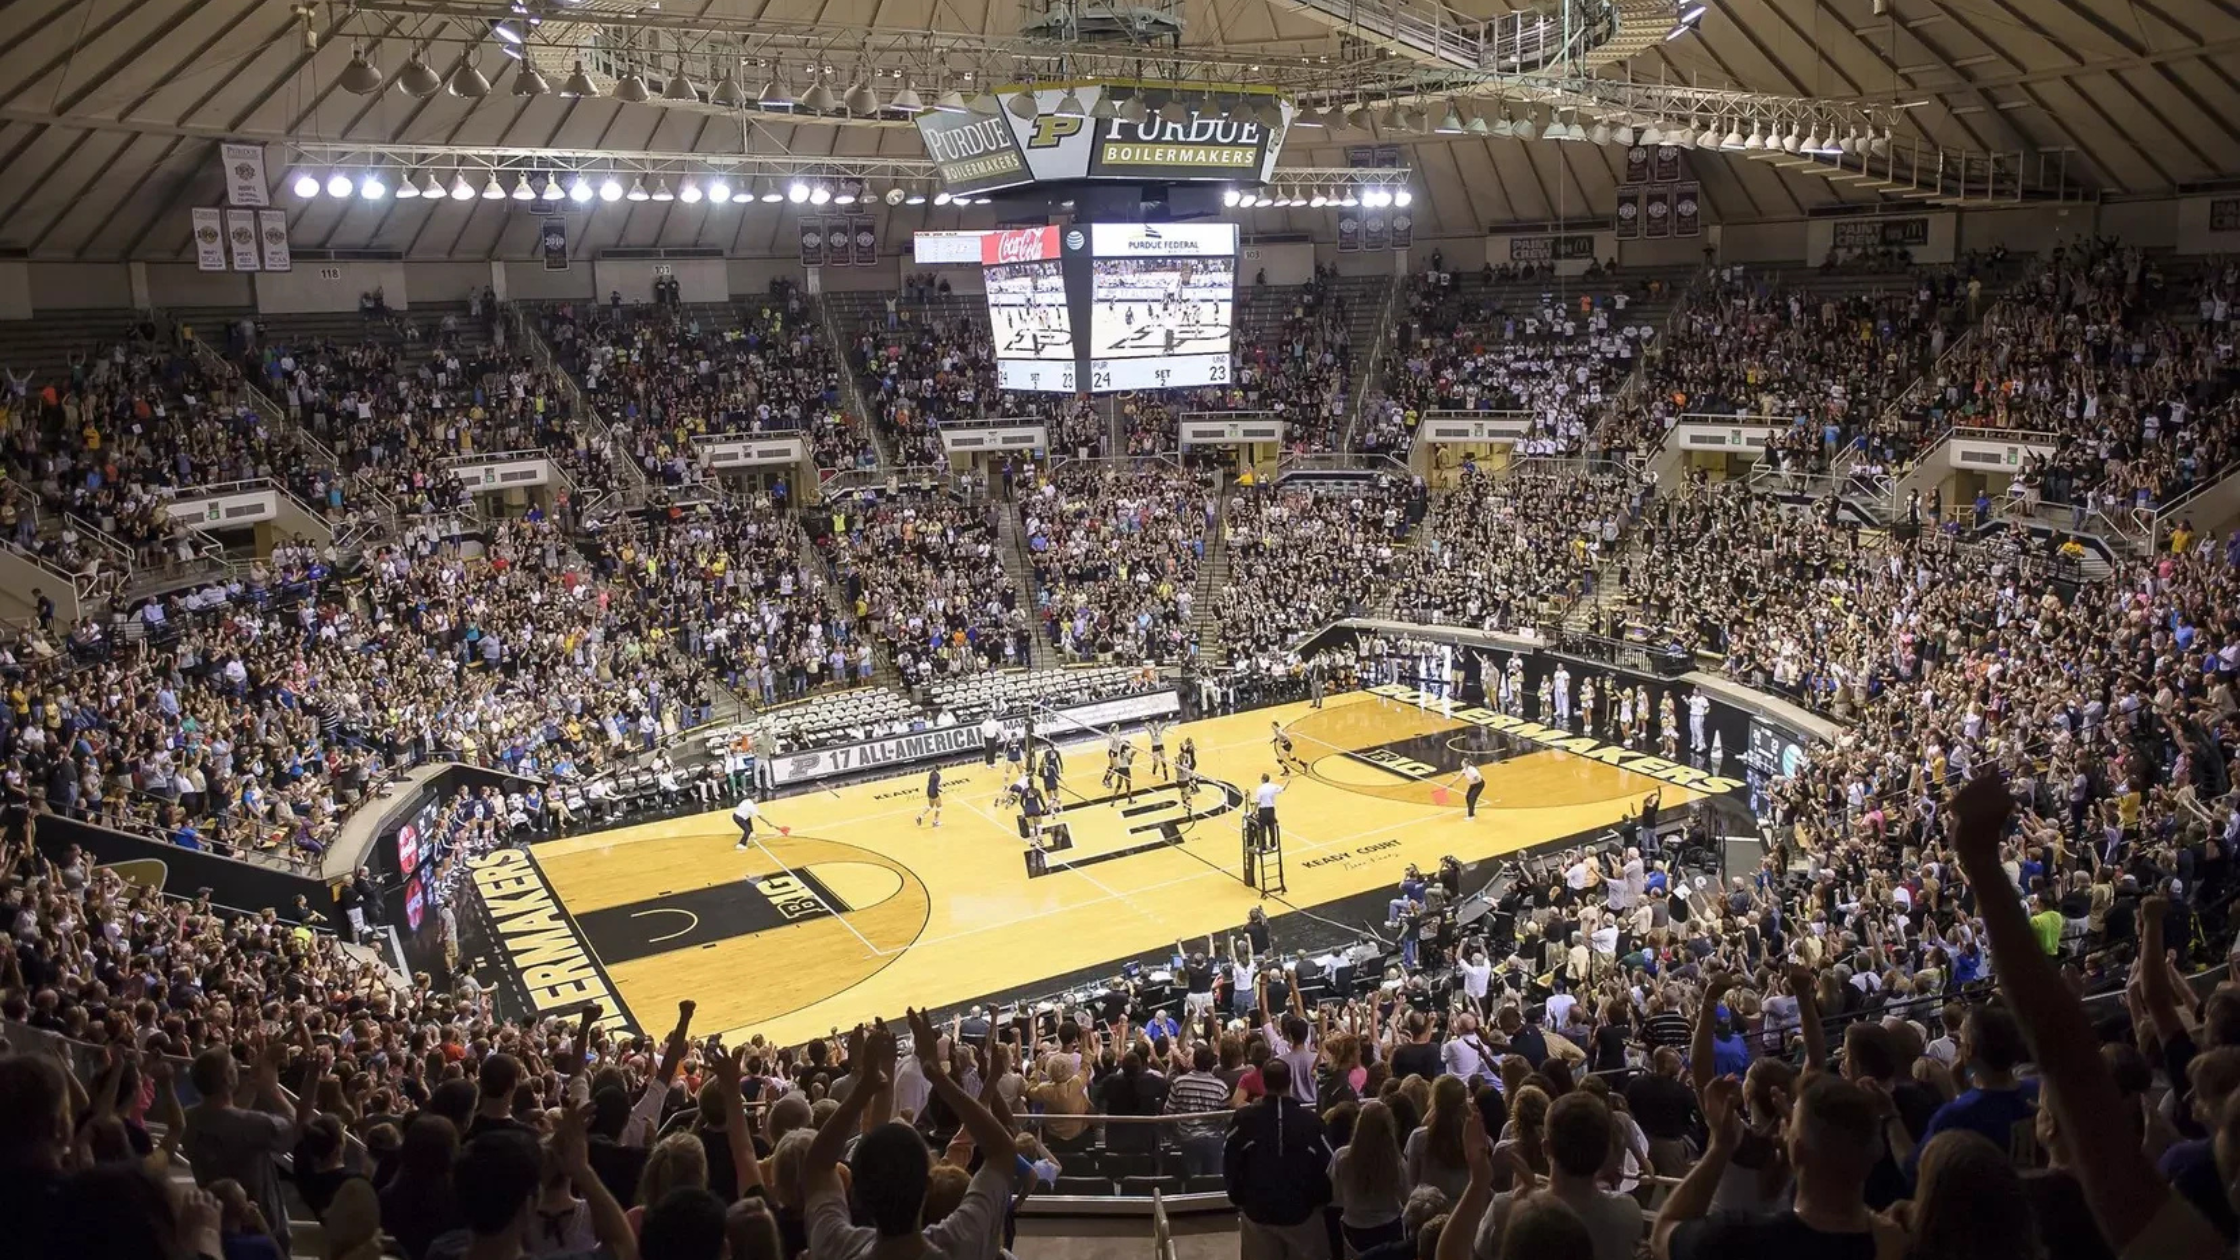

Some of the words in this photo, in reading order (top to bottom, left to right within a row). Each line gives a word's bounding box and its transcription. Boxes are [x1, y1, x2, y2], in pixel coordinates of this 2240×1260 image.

[925, 118, 1011, 162] PURDUE
[1107, 147, 1255, 164] BOILERMAKERS
[942, 154, 1020, 180] BOILERMAKERS
[1128, 241, 1162, 249] PURDUE
[1164, 241, 1199, 249] FEDERAL
[1512, 240, 1555, 249] PAINT
[1246, 250, 1260, 259] 103
[321, 269, 340, 279] 118
[1062, 373, 1074, 388] 23
[1094, 372, 1111, 388] 24
[1155, 369, 1171, 379] SET
[1210, 365, 1227, 381] 23
[829, 750, 851, 770] 17
[1302, 852, 1351, 868] KEADY
[1357, 839, 1402, 854] COURT
